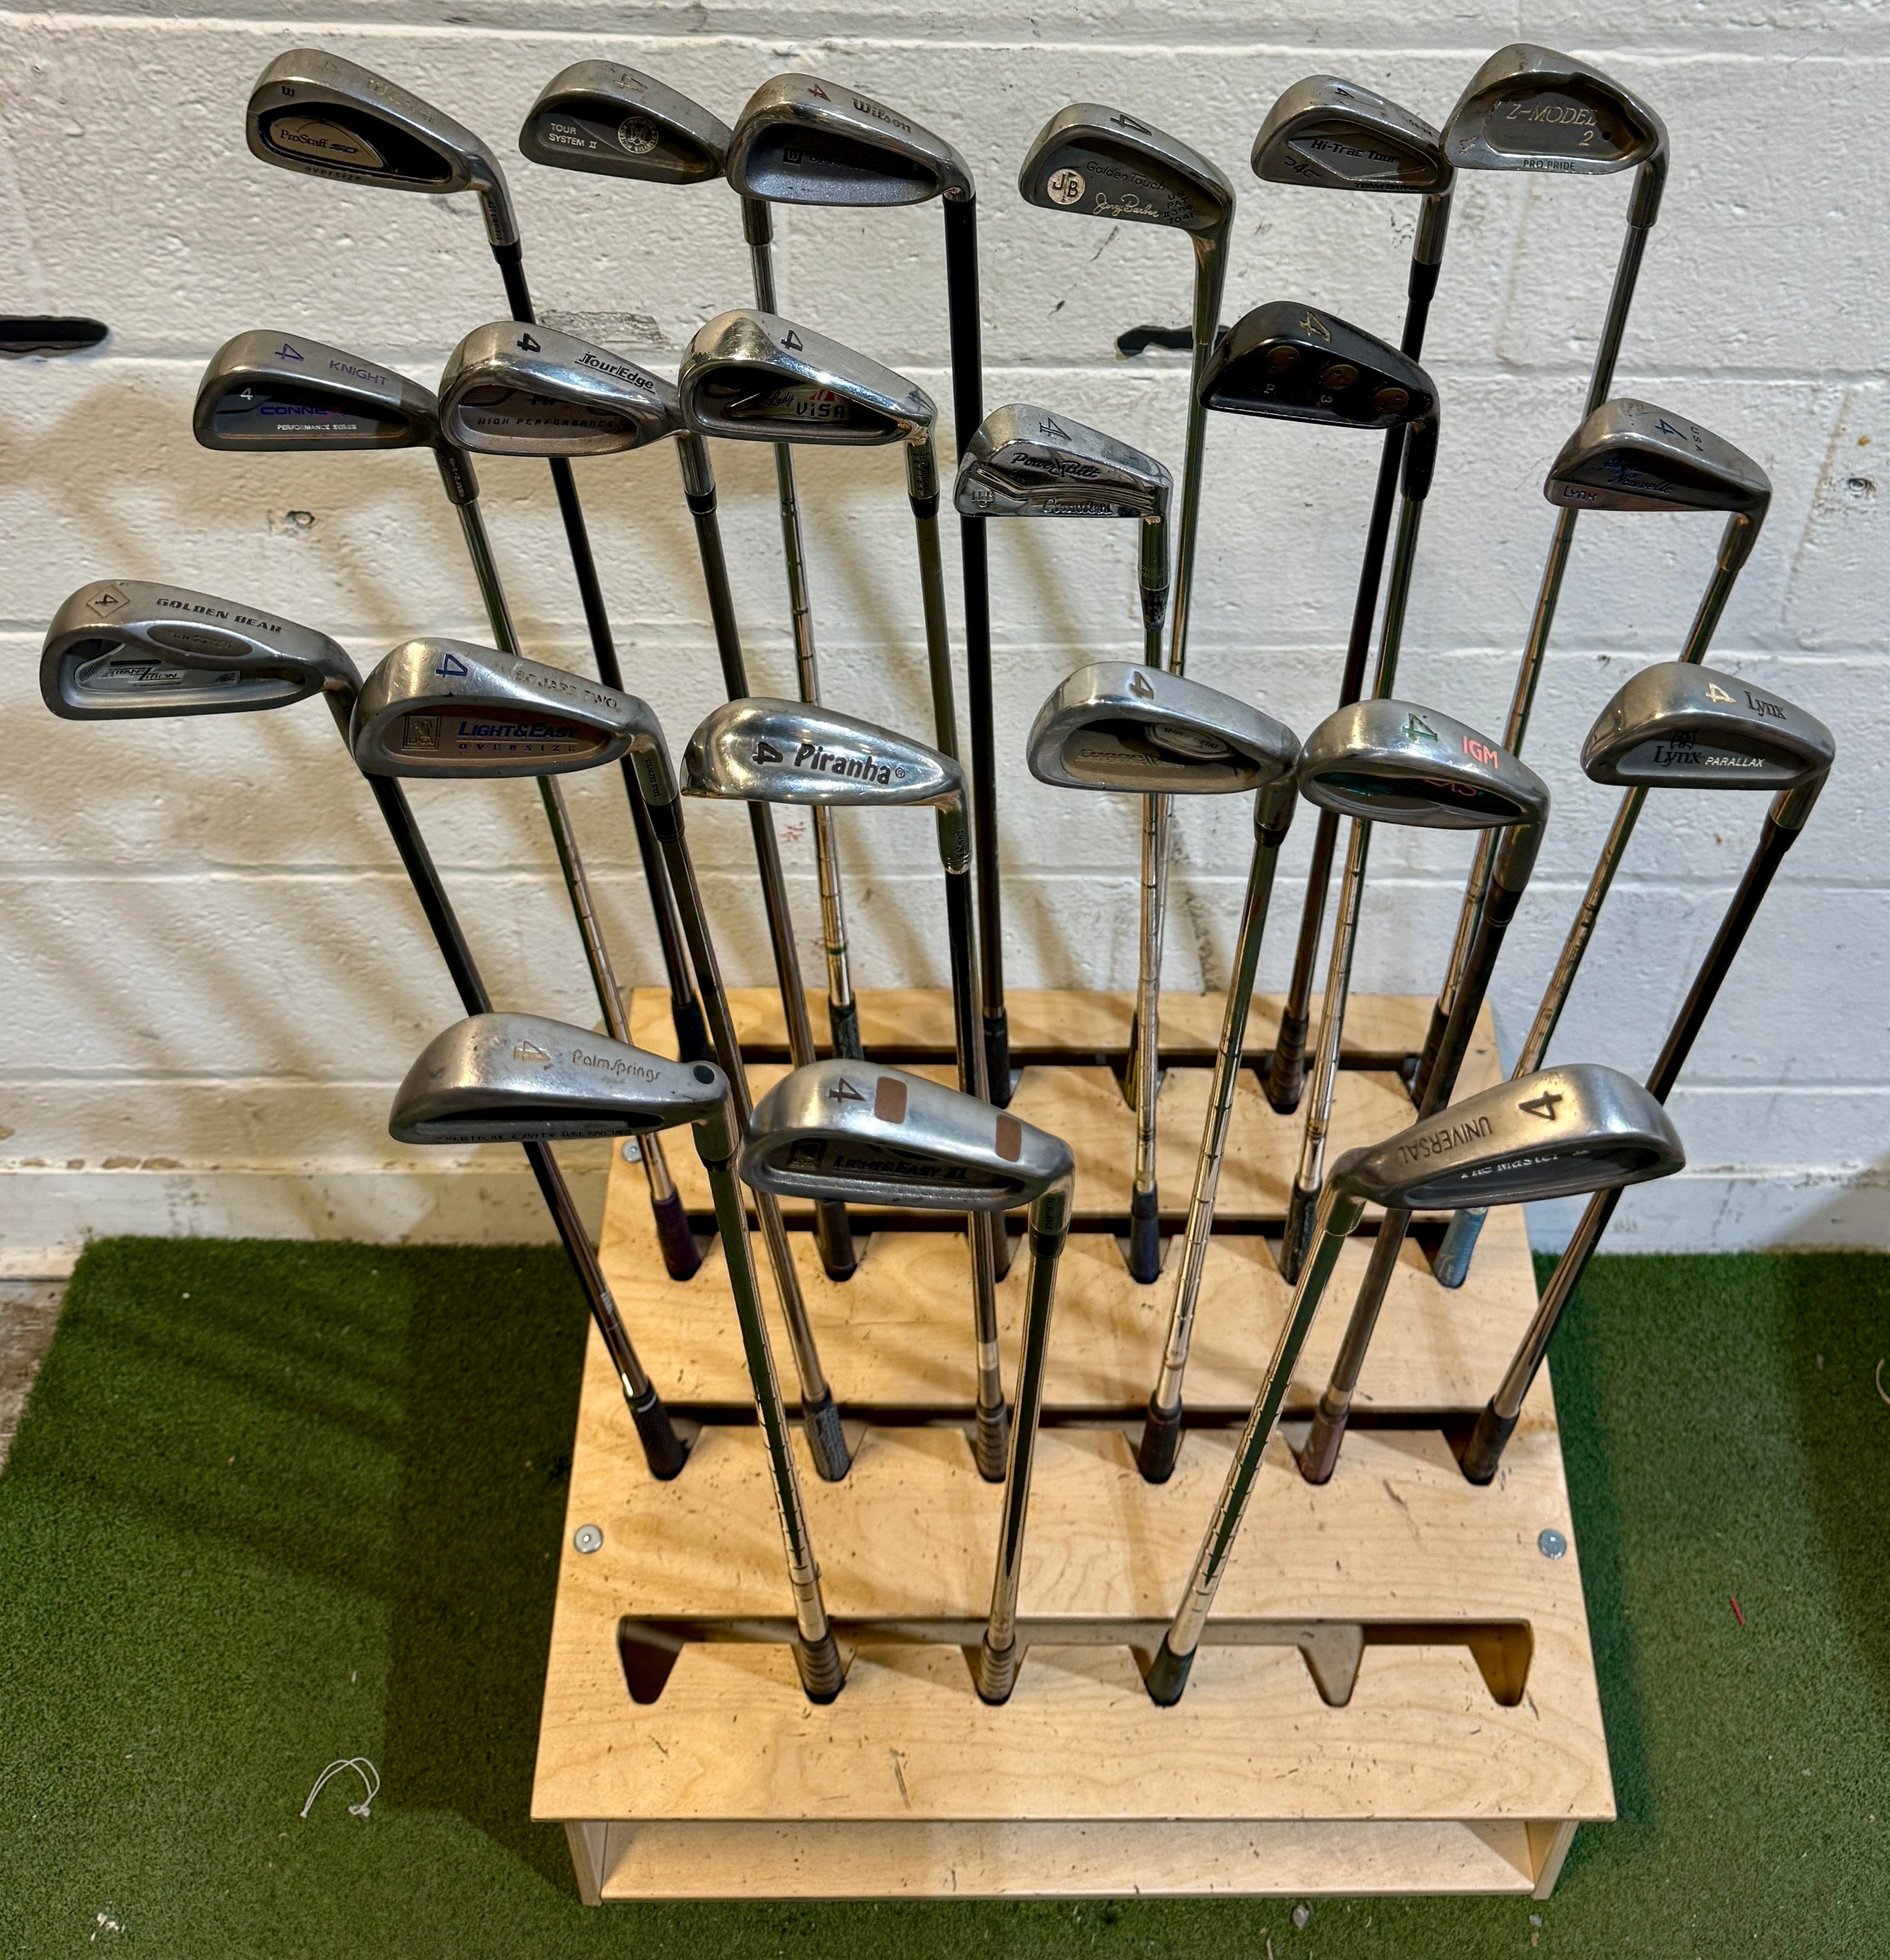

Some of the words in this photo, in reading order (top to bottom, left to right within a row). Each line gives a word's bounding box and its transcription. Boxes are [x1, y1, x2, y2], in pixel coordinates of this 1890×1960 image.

[612, 73, 648, 93] 4
[807, 83, 831, 102] 4
[852, 97, 912, 134] Wilson
[1110, 113, 1152, 136] 4
[1506, 103, 1598, 127] Z-MODEL
[550, 123, 577, 135] TOUR
[1578, 129, 1594, 147] 2
[548, 133, 585, 147] SYSTEM
[589, 141, 597, 149] II
[1311, 138, 1364, 158] Hi-Trac
[1367, 149, 1402, 164] Tour
[1295, 163, 1306, 173] 4
[1523, 159, 1544, 170] PRO
[1547, 160, 1576, 171] PRIDE
[1093, 192, 1124, 217] Jerry
[1120, 194, 1159, 217] Barber
[1167, 190, 1185, 200] US
[1167, 197, 1188, 209] PAT
[1299, 310, 1331, 343] 4
[516, 332, 542, 353] 4
[780, 329, 804, 352] 4
[275, 343, 305, 362] 4
[330, 359, 389, 387] KNIGHT
[240, 387, 253, 401] 4
[763, 390, 796, 408] Lady
[796, 401, 846, 419] VISA
[477, 417, 510, 426] HIGH
[516, 418, 615, 428] PERFORMANCE
[1038, 416, 1073, 441] 4
[1654, 418, 1688, 441] 4
[1690, 425, 1705, 452] USA
[1606, 473, 1676, 495] Nouvelle
[94, 593, 119, 607] 4
[155, 597, 230, 620] GOLDEN
[234, 615, 283, 634] BEAR
[435, 653, 468, 679] 4
[1128, 670, 1155, 700] 4
[1705, 682, 1736, 705] 4
[1743, 690, 1787, 721] Lynx
[1402, 712, 1439, 743] 4
[458, 743, 576, 753] OVERSIZE
[751, 741, 784, 765] 4
[1462, 735, 1498, 770] IGM
[1653, 744, 1703, 767] Lynx
[1704, 756, 1766, 768] PARALLAX
[513, 1040, 552, 1063] 4
[828, 1077, 866, 1103] 4
[1517, 1090, 1563, 1122] 4
[1397, 1115, 1494, 1165] UNIVERSAL
[944, 1166, 969, 1180] XL
